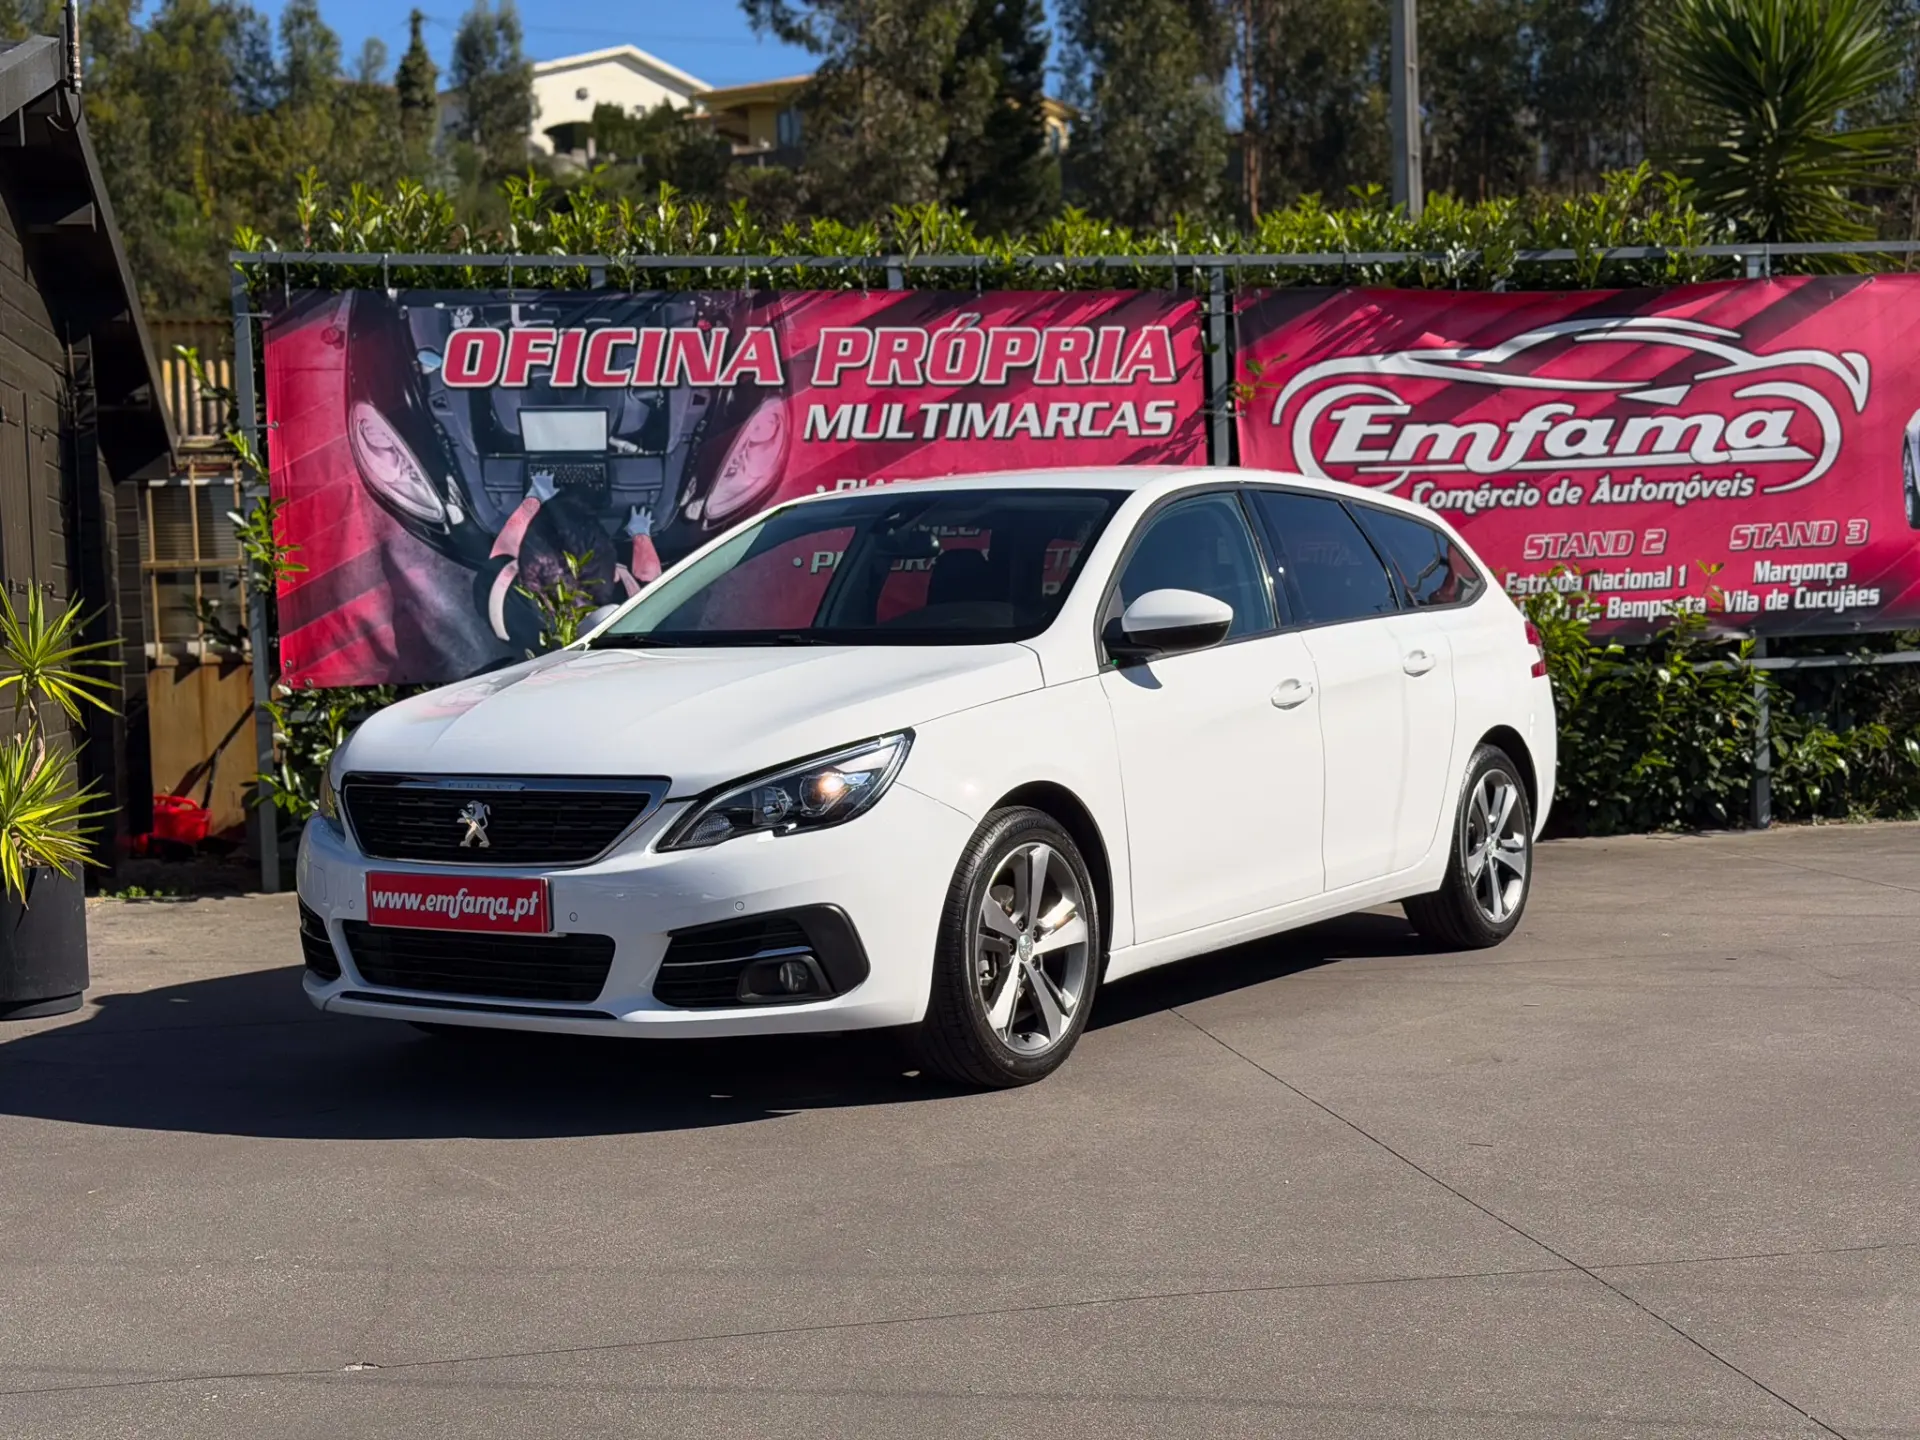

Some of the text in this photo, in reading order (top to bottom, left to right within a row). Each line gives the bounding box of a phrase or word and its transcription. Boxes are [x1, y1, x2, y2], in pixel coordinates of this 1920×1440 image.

[442, 313, 1177, 387] OFICINA PRÓPRIA
[804, 400, 1175, 440] MULTIMARCAS
[1322, 404, 1796, 474] Emfama
[1412, 472, 1756, 514] Comércio de Automóveis
[1523, 528, 1667, 560] STAND 2
[1729, 518, 1869, 550] STAND 3
[1589, 565, 1673, 593] Nacional
[1678, 564, 1687, 588] 1
[1753, 560, 1848, 587] Margonça
[1606, 595, 1707, 623] Bempota
[1724, 584, 1880, 614] Vila de Cucujães
[371, 887, 539, 923] www.emfama.pt
